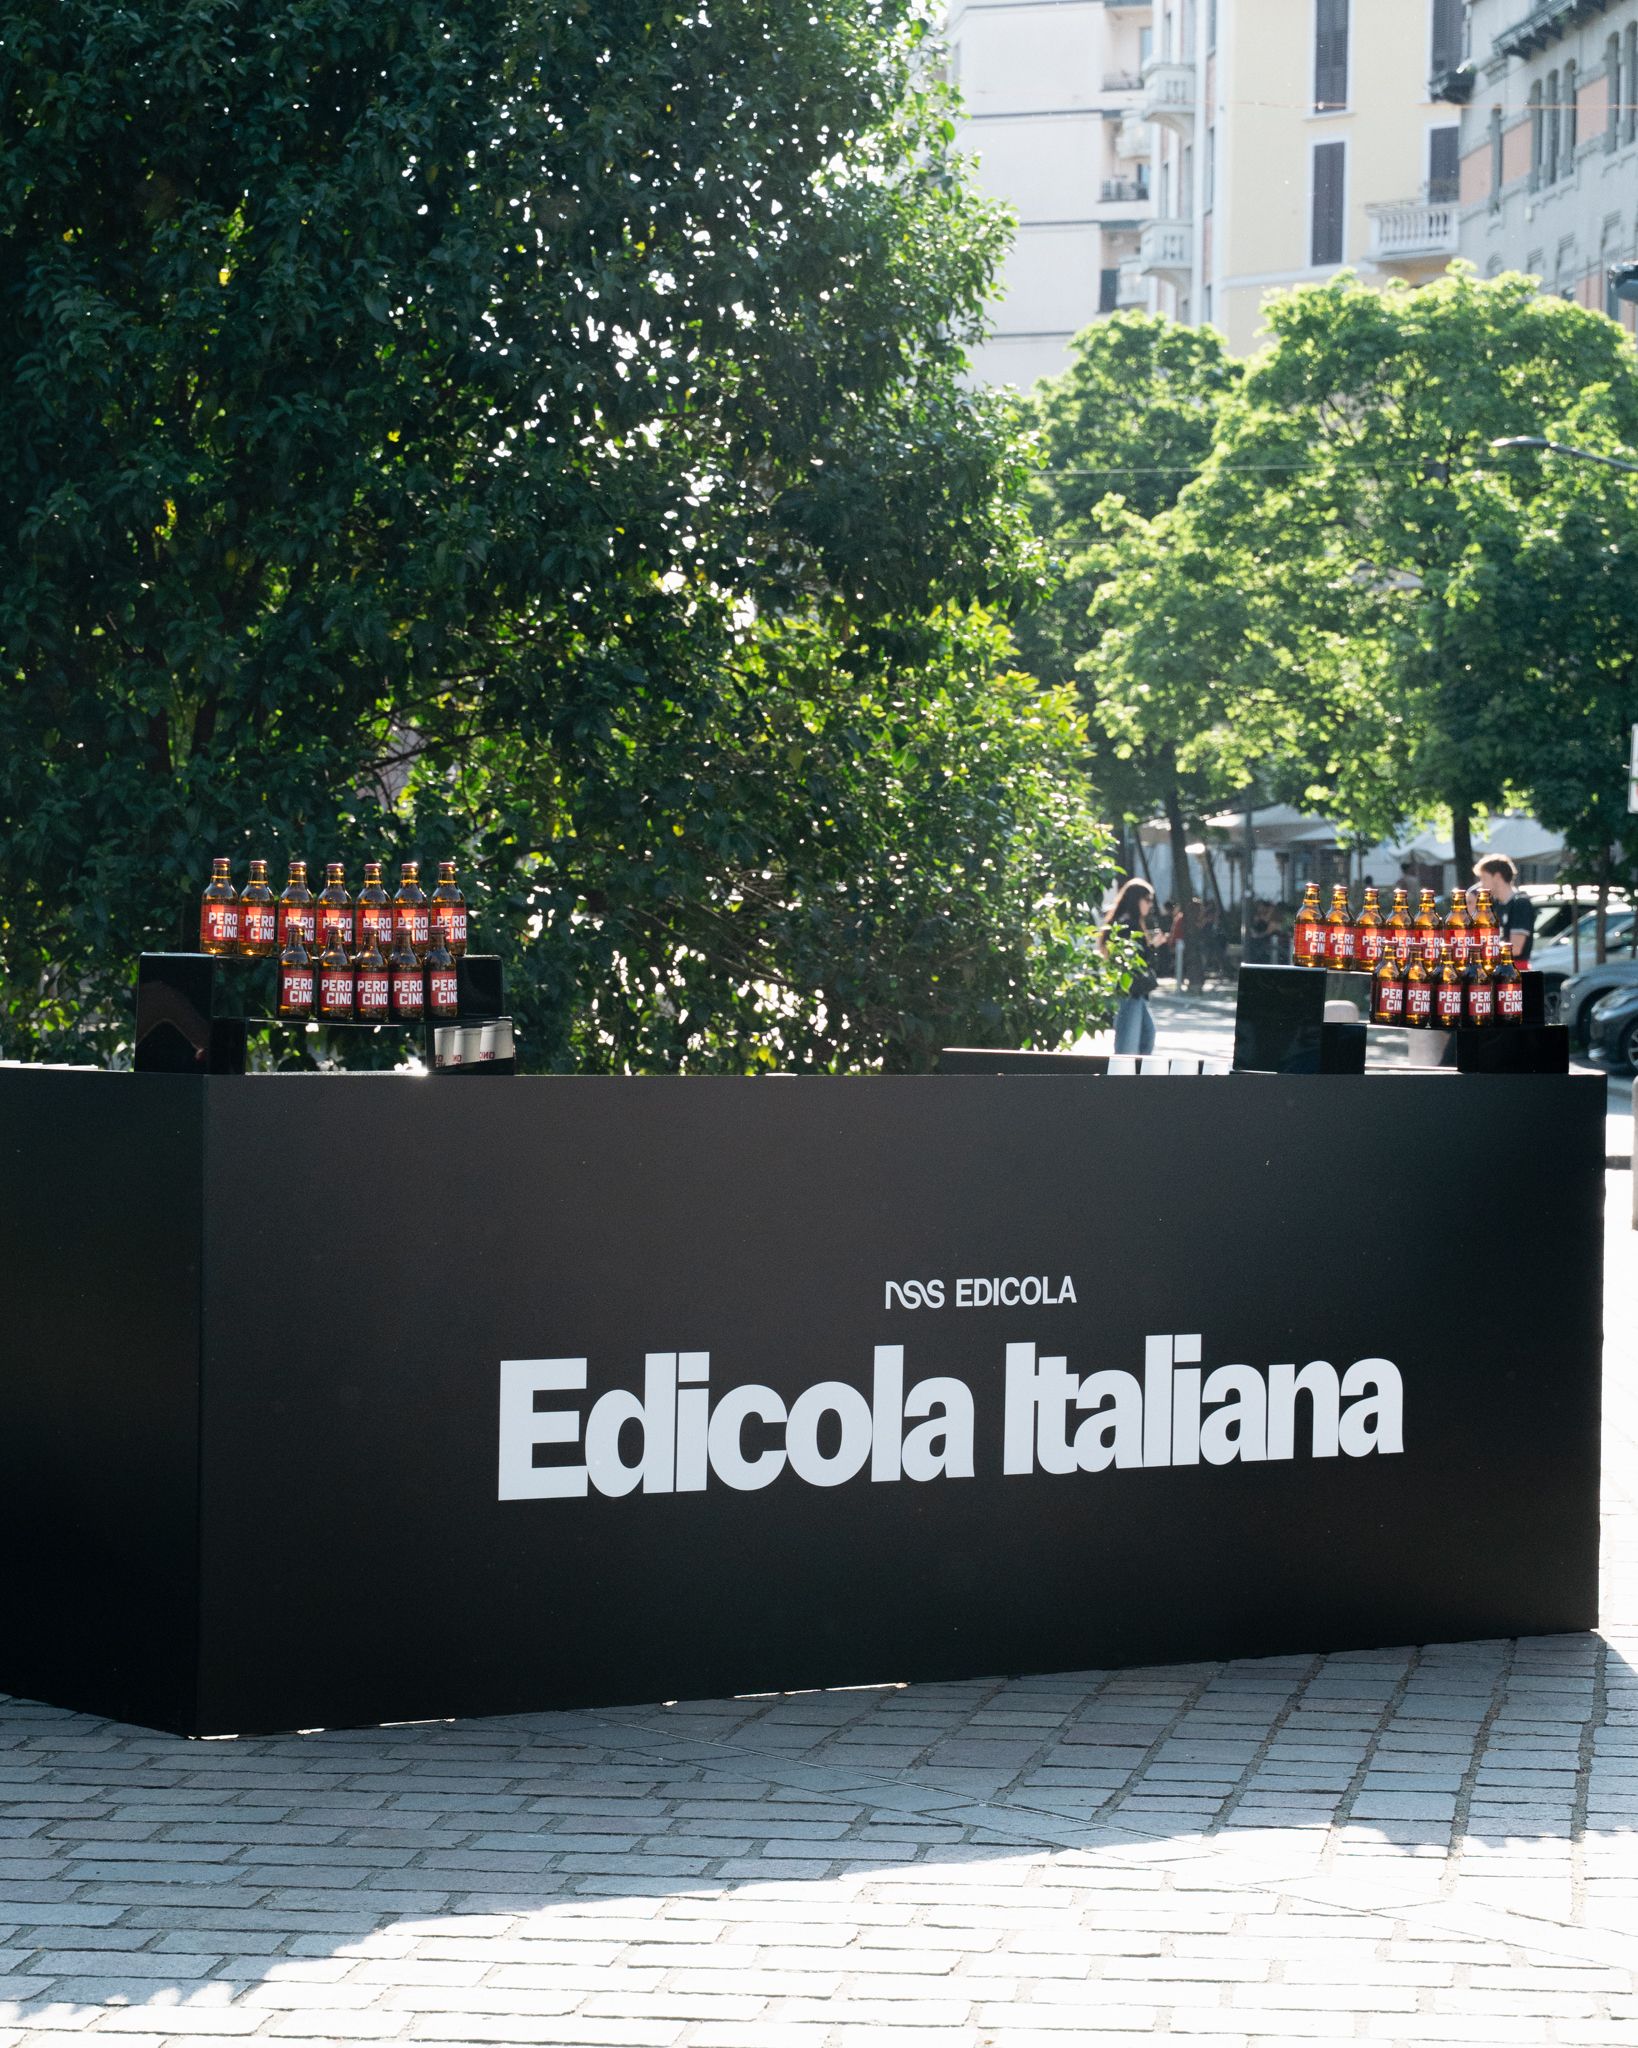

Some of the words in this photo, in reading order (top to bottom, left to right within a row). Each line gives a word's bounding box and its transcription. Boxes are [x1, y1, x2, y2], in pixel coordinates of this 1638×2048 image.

[1412, 1001, 1430, 1013] CIN
[956, 1275, 1077, 1307] EDICOLA
[498, 1345, 975, 1501] Edicola
[1004, 1334, 1404, 1476] Italiana
